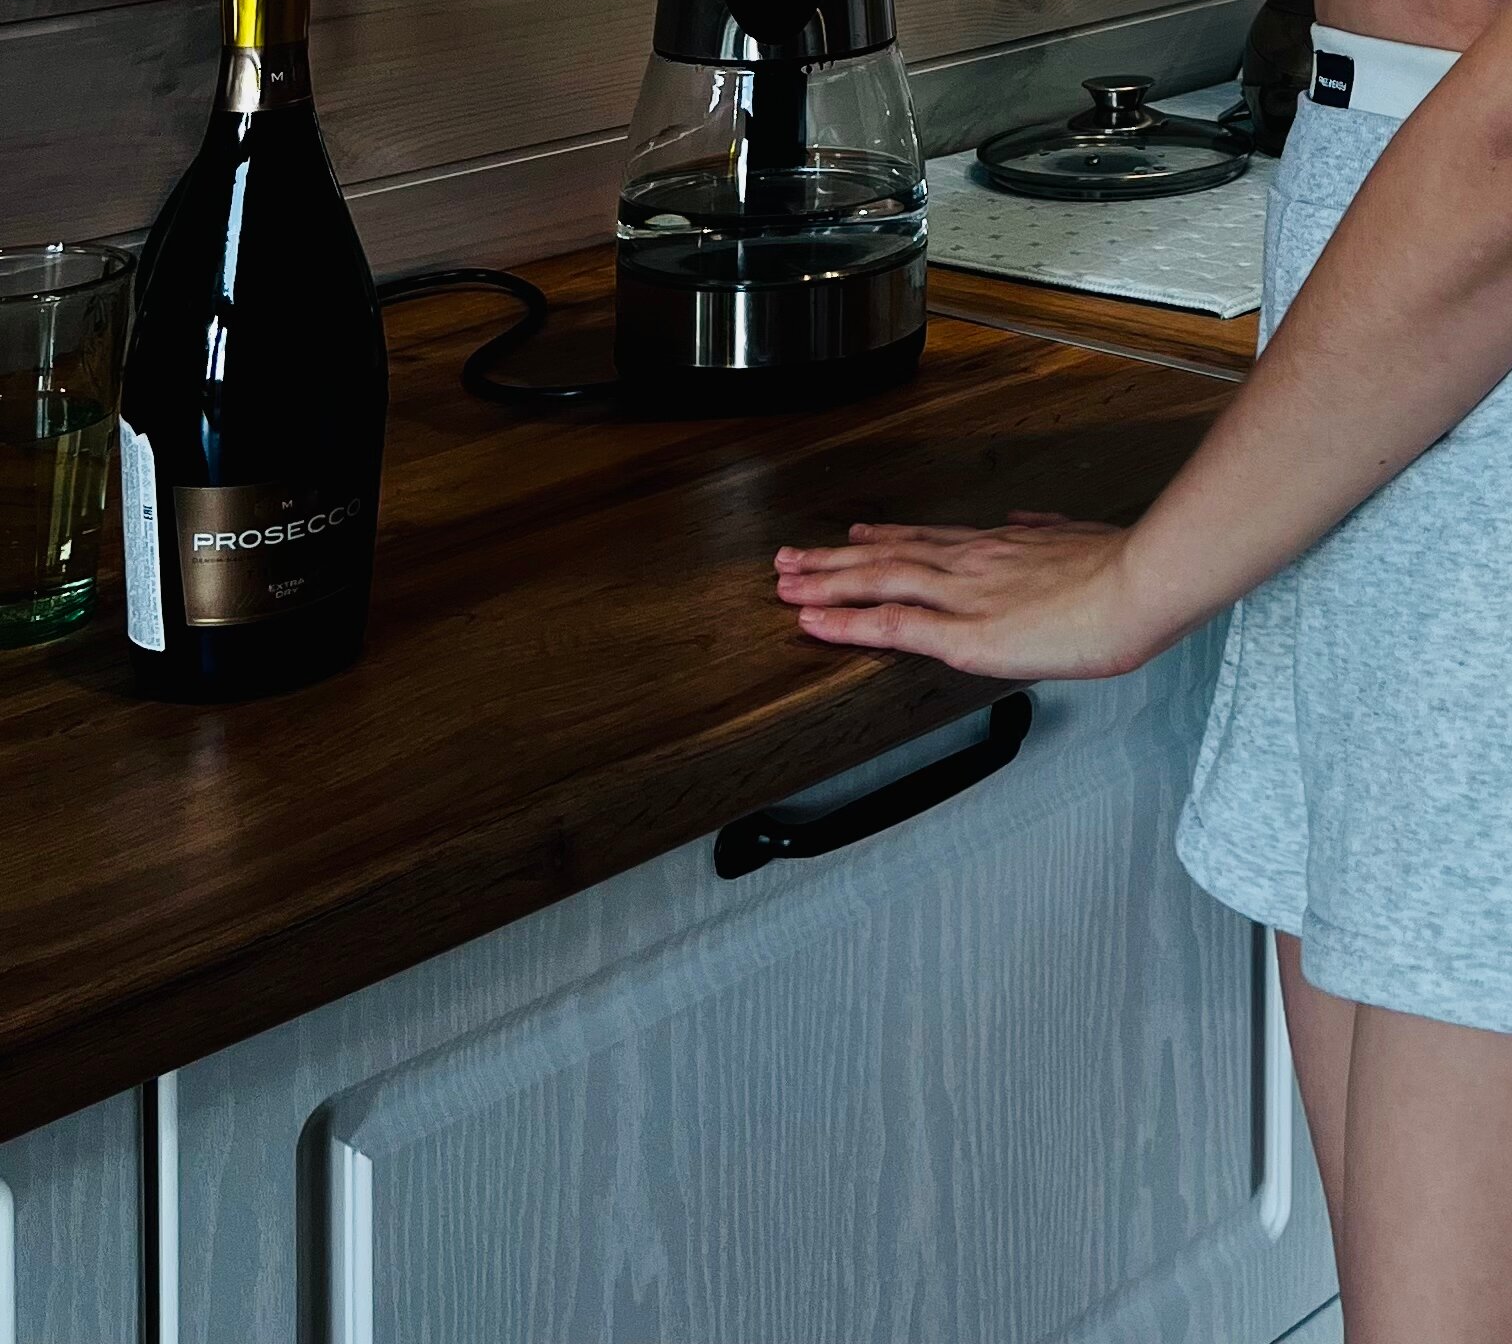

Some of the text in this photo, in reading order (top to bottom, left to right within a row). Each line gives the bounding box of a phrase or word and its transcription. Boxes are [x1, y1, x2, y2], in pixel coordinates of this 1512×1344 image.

[270, 71, 284, 82] M
[281, 499, 293, 511] M
[192, 497, 361, 551] PROSECCO
[268, 577, 304, 593] EXTRA
[275, 586, 299, 599] DRY
